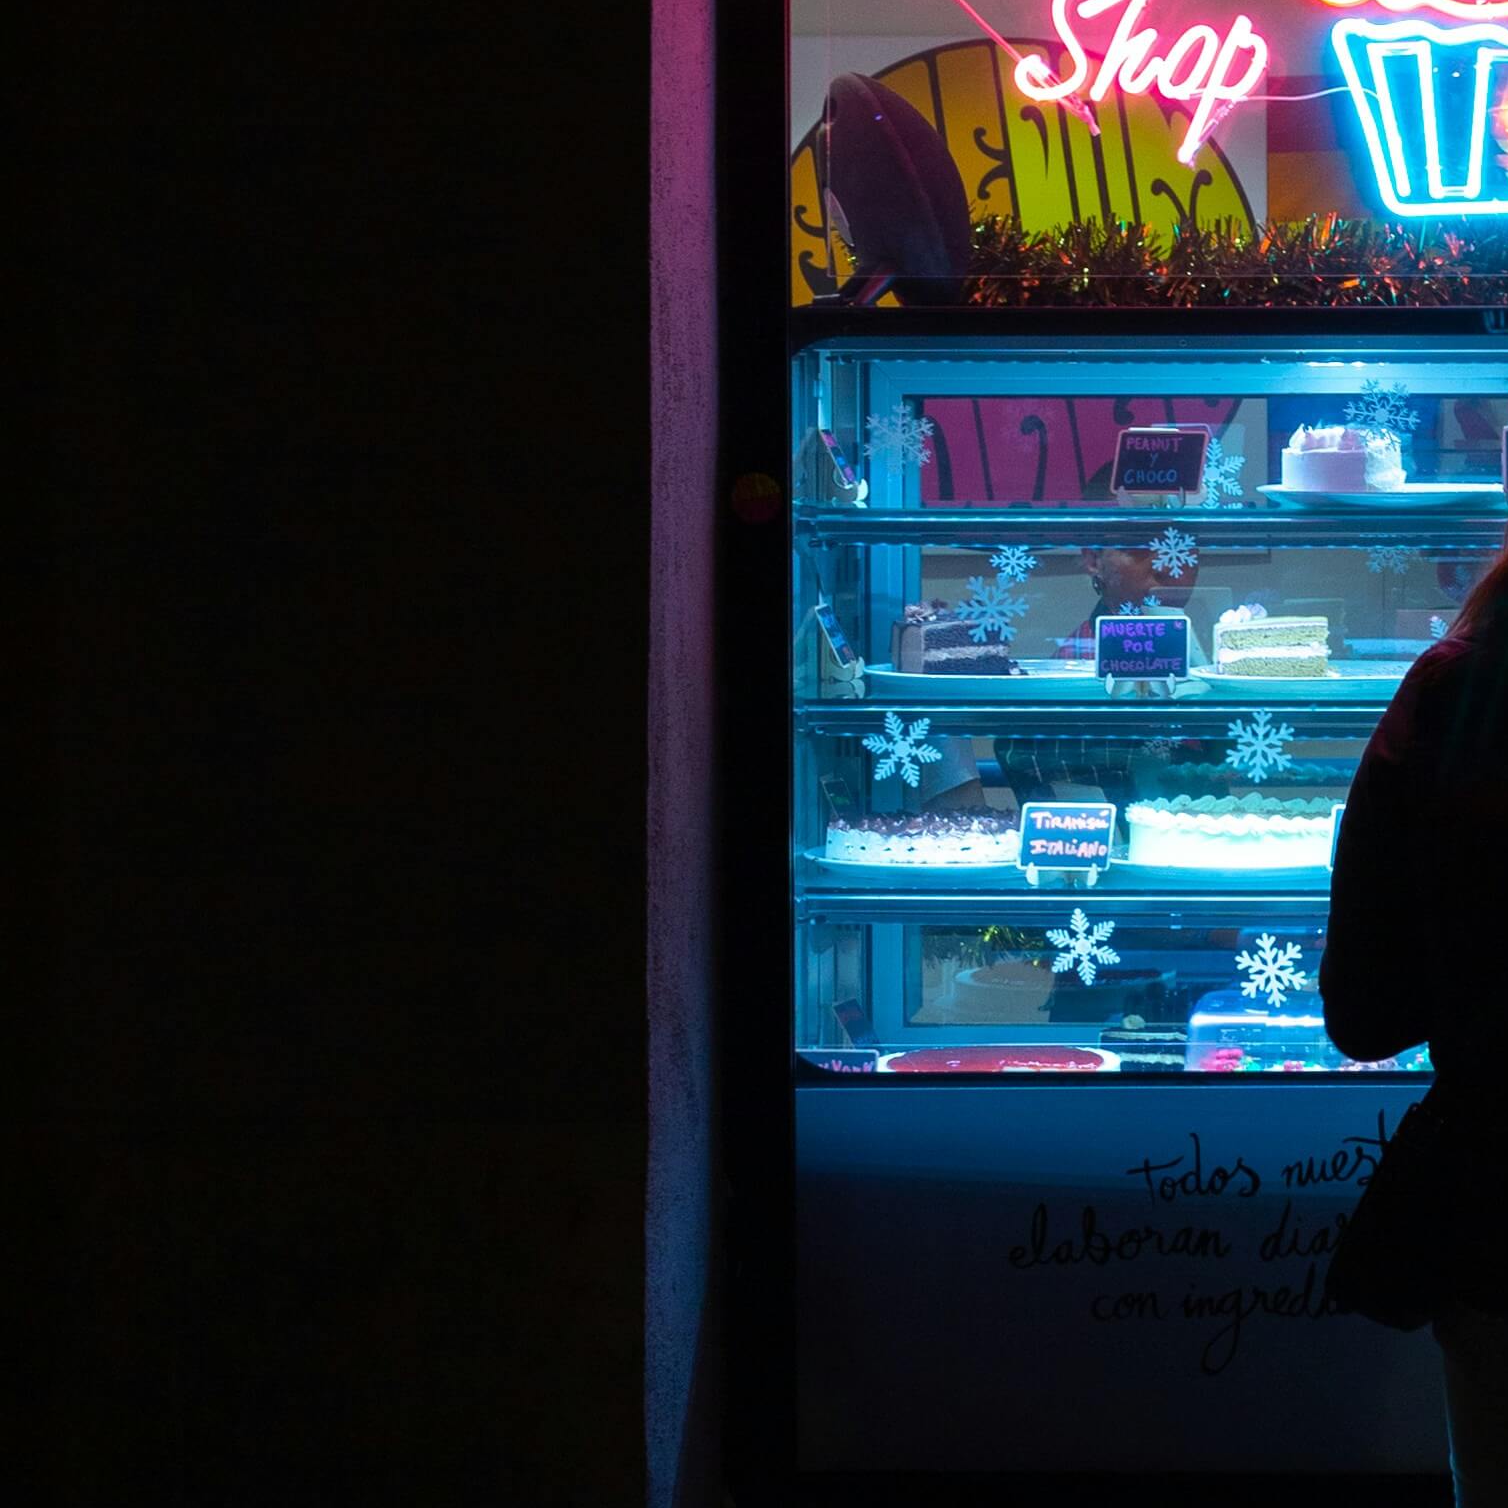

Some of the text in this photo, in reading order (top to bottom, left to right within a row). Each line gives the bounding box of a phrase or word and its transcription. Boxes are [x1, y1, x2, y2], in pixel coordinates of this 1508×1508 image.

[1126, 437, 1183, 452] PEANUT
[1123, 469, 1178, 485] CHOCO
[1101, 621, 1166, 638] MUERTE
[1123, 639, 1155, 653] POR
[1101, 657, 1183, 672] CHOCOLATE
[1281, 1108, 1390, 1188] nuest
[1009, 1204, 1232, 1269] elaboran
[1092, 1289, 1162, 1321] con
